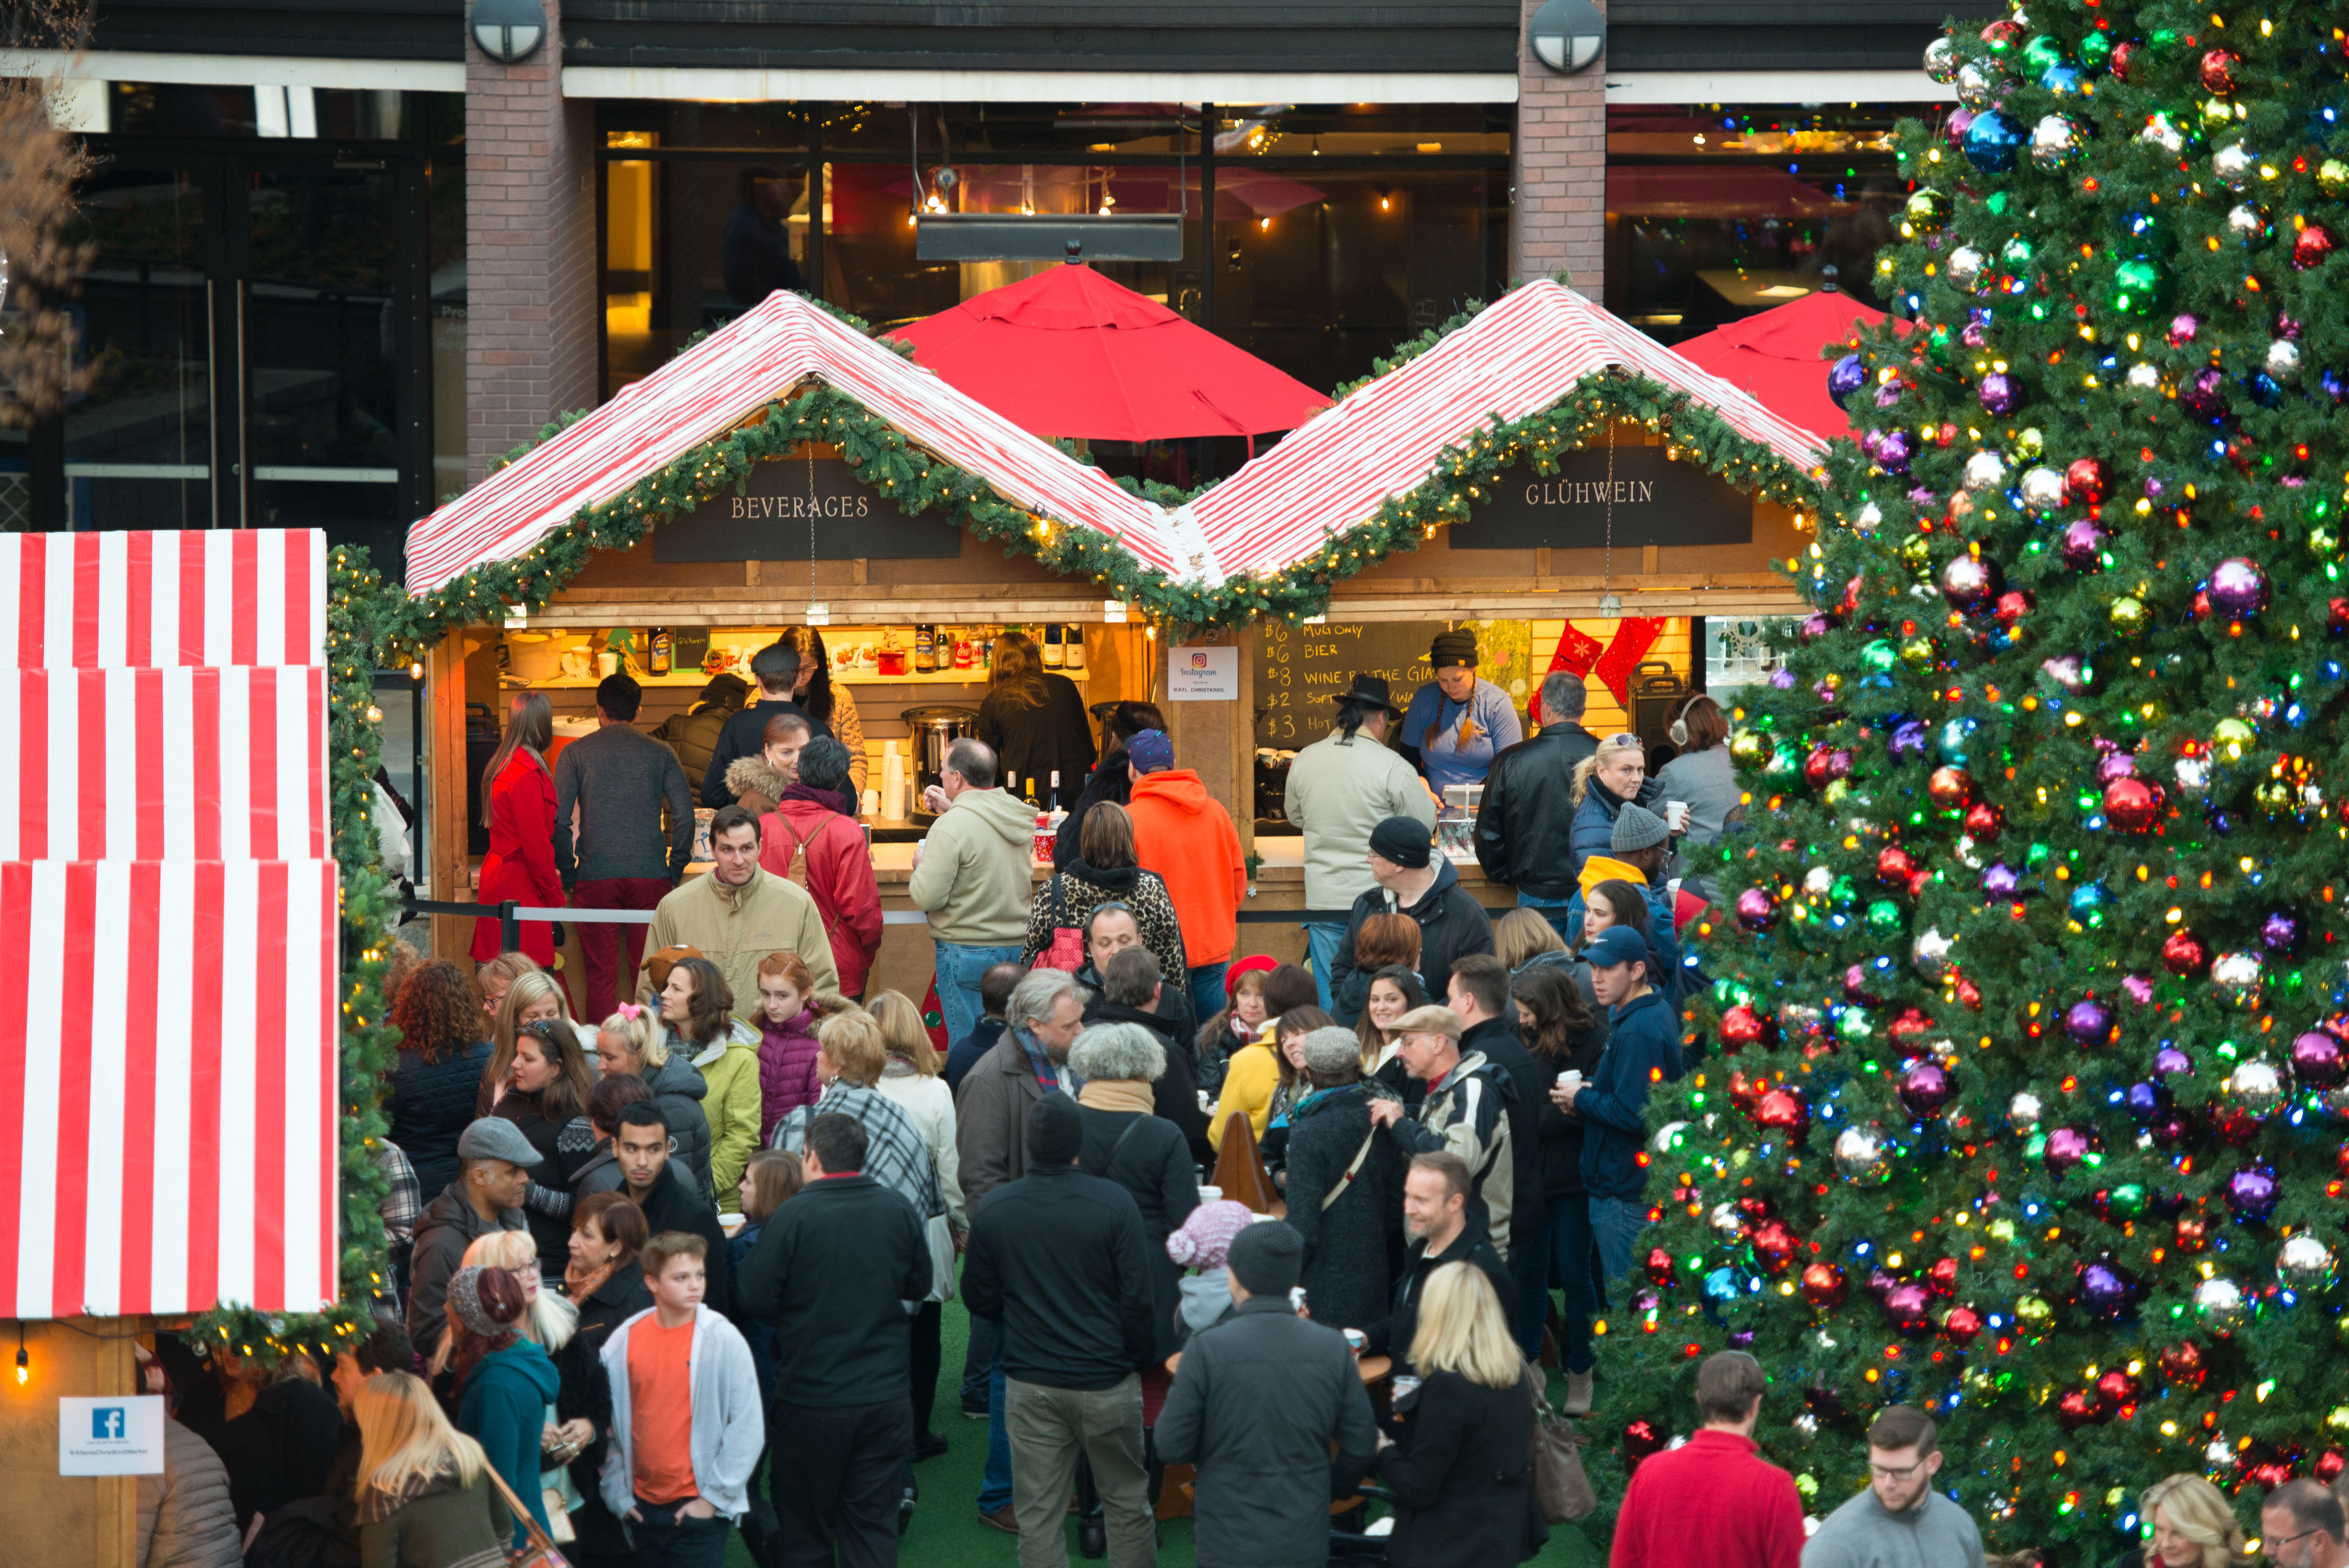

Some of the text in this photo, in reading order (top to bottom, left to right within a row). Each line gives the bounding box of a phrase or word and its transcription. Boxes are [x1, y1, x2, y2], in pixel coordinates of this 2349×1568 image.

[1526, 479, 1653, 505] GLÜHWEIN
[731, 496, 868, 518] BEVERAGES
[1304, 644, 1338, 658] BIER
[1180, 668, 1217, 678] Instagram
[1304, 671, 1341, 684] WINE
[1372, 669, 1401, 682] THE
